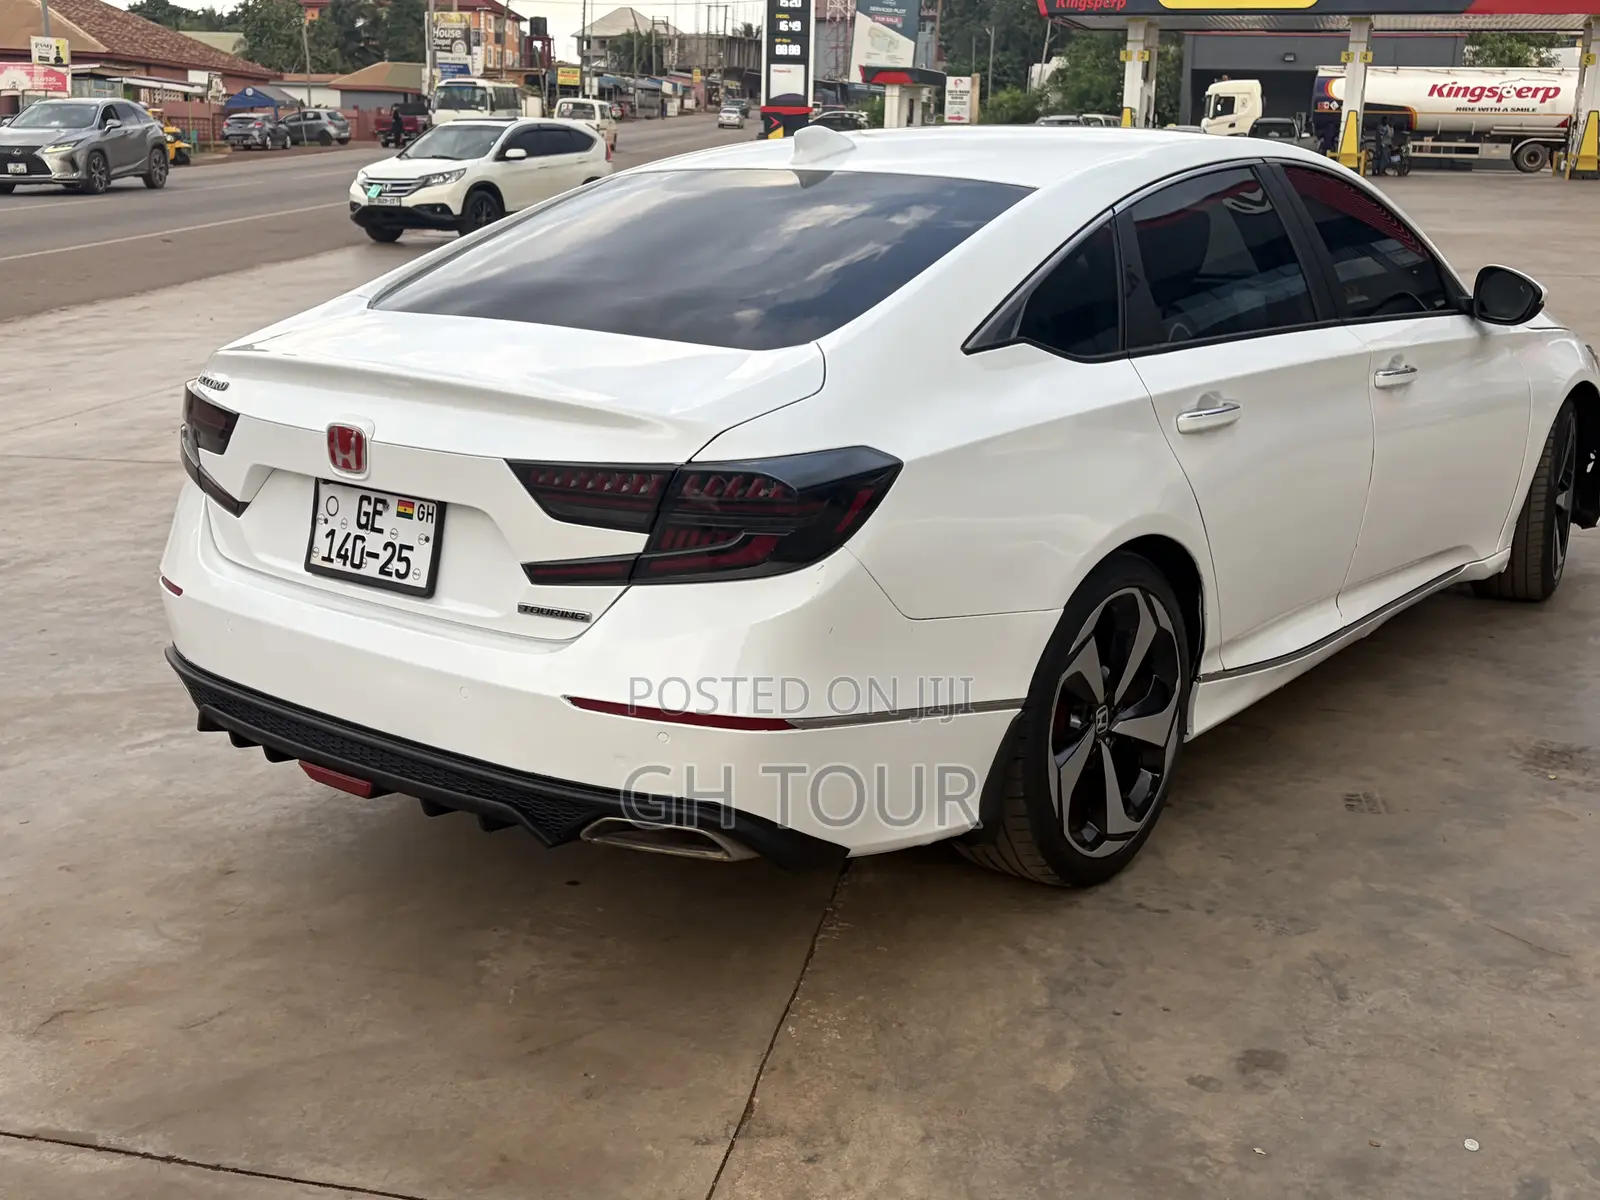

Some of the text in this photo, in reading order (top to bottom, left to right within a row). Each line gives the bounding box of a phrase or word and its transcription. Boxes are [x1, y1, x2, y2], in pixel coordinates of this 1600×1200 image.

[1055, 0, 1127, 12] Kingsperp
[433, 27, 462, 39] House
[1344, 53, 1351, 62] 3
[1584, 55, 1592, 64] 5
[1427, 81, 1561, 104] Kingsperp
[356, 494, 435, 535] GE GH
[320, 528, 415, 580] 140-25
[520, 604, 586, 621] TOURING
